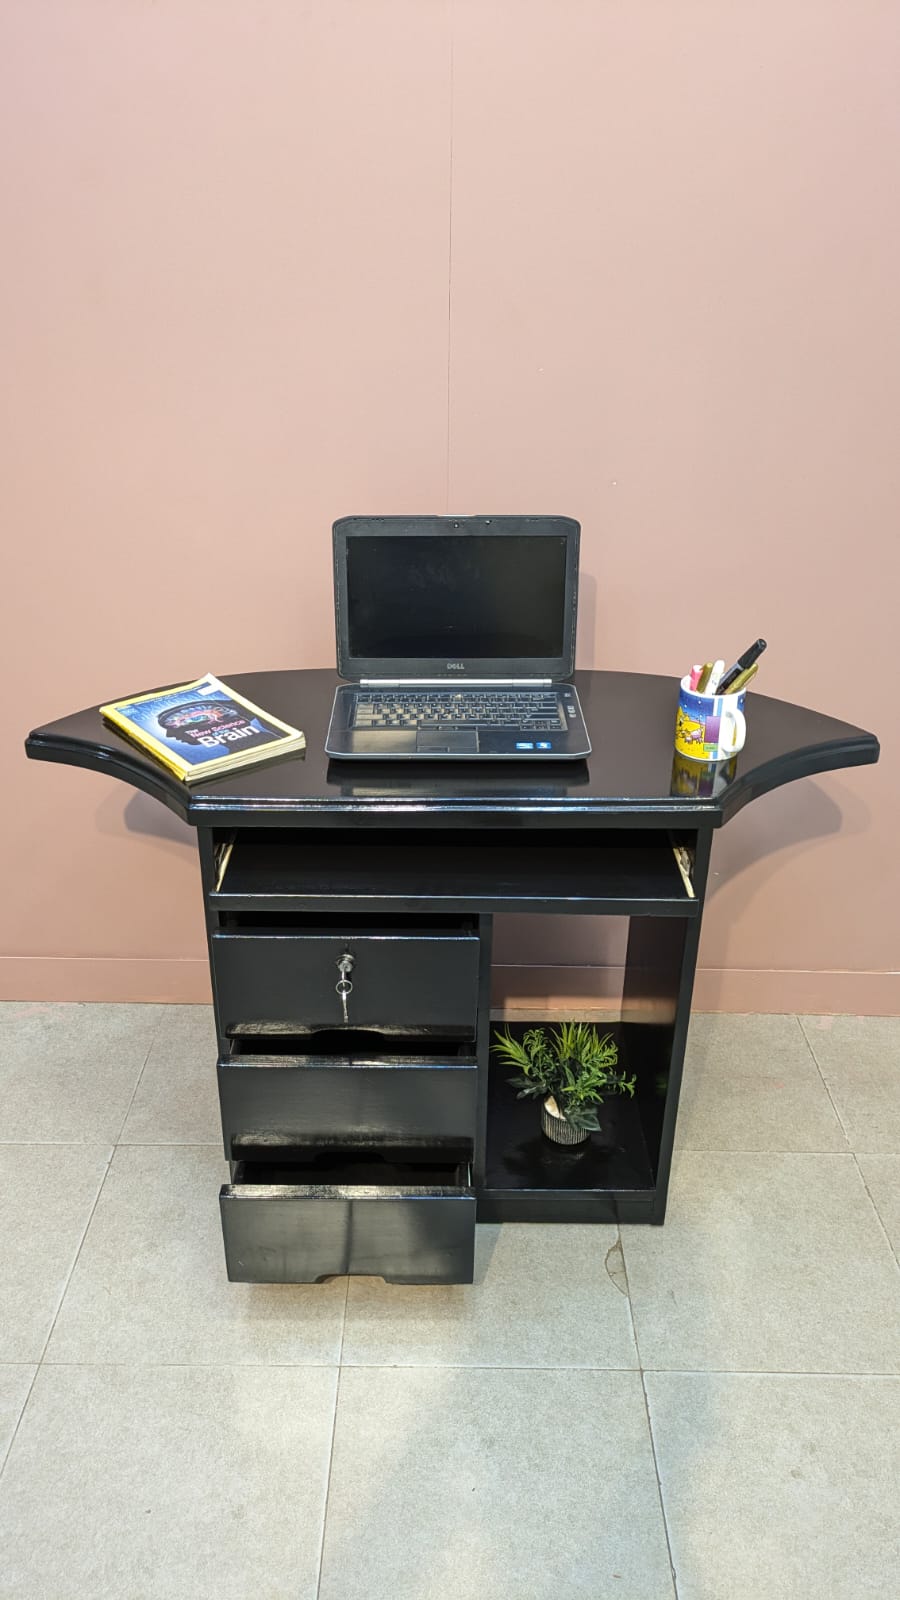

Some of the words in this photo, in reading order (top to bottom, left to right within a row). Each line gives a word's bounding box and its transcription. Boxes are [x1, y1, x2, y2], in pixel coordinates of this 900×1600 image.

[190, 729, 211, 738] New
[211, 720, 246, 731] Science
[197, 726, 260, 748] Brain
